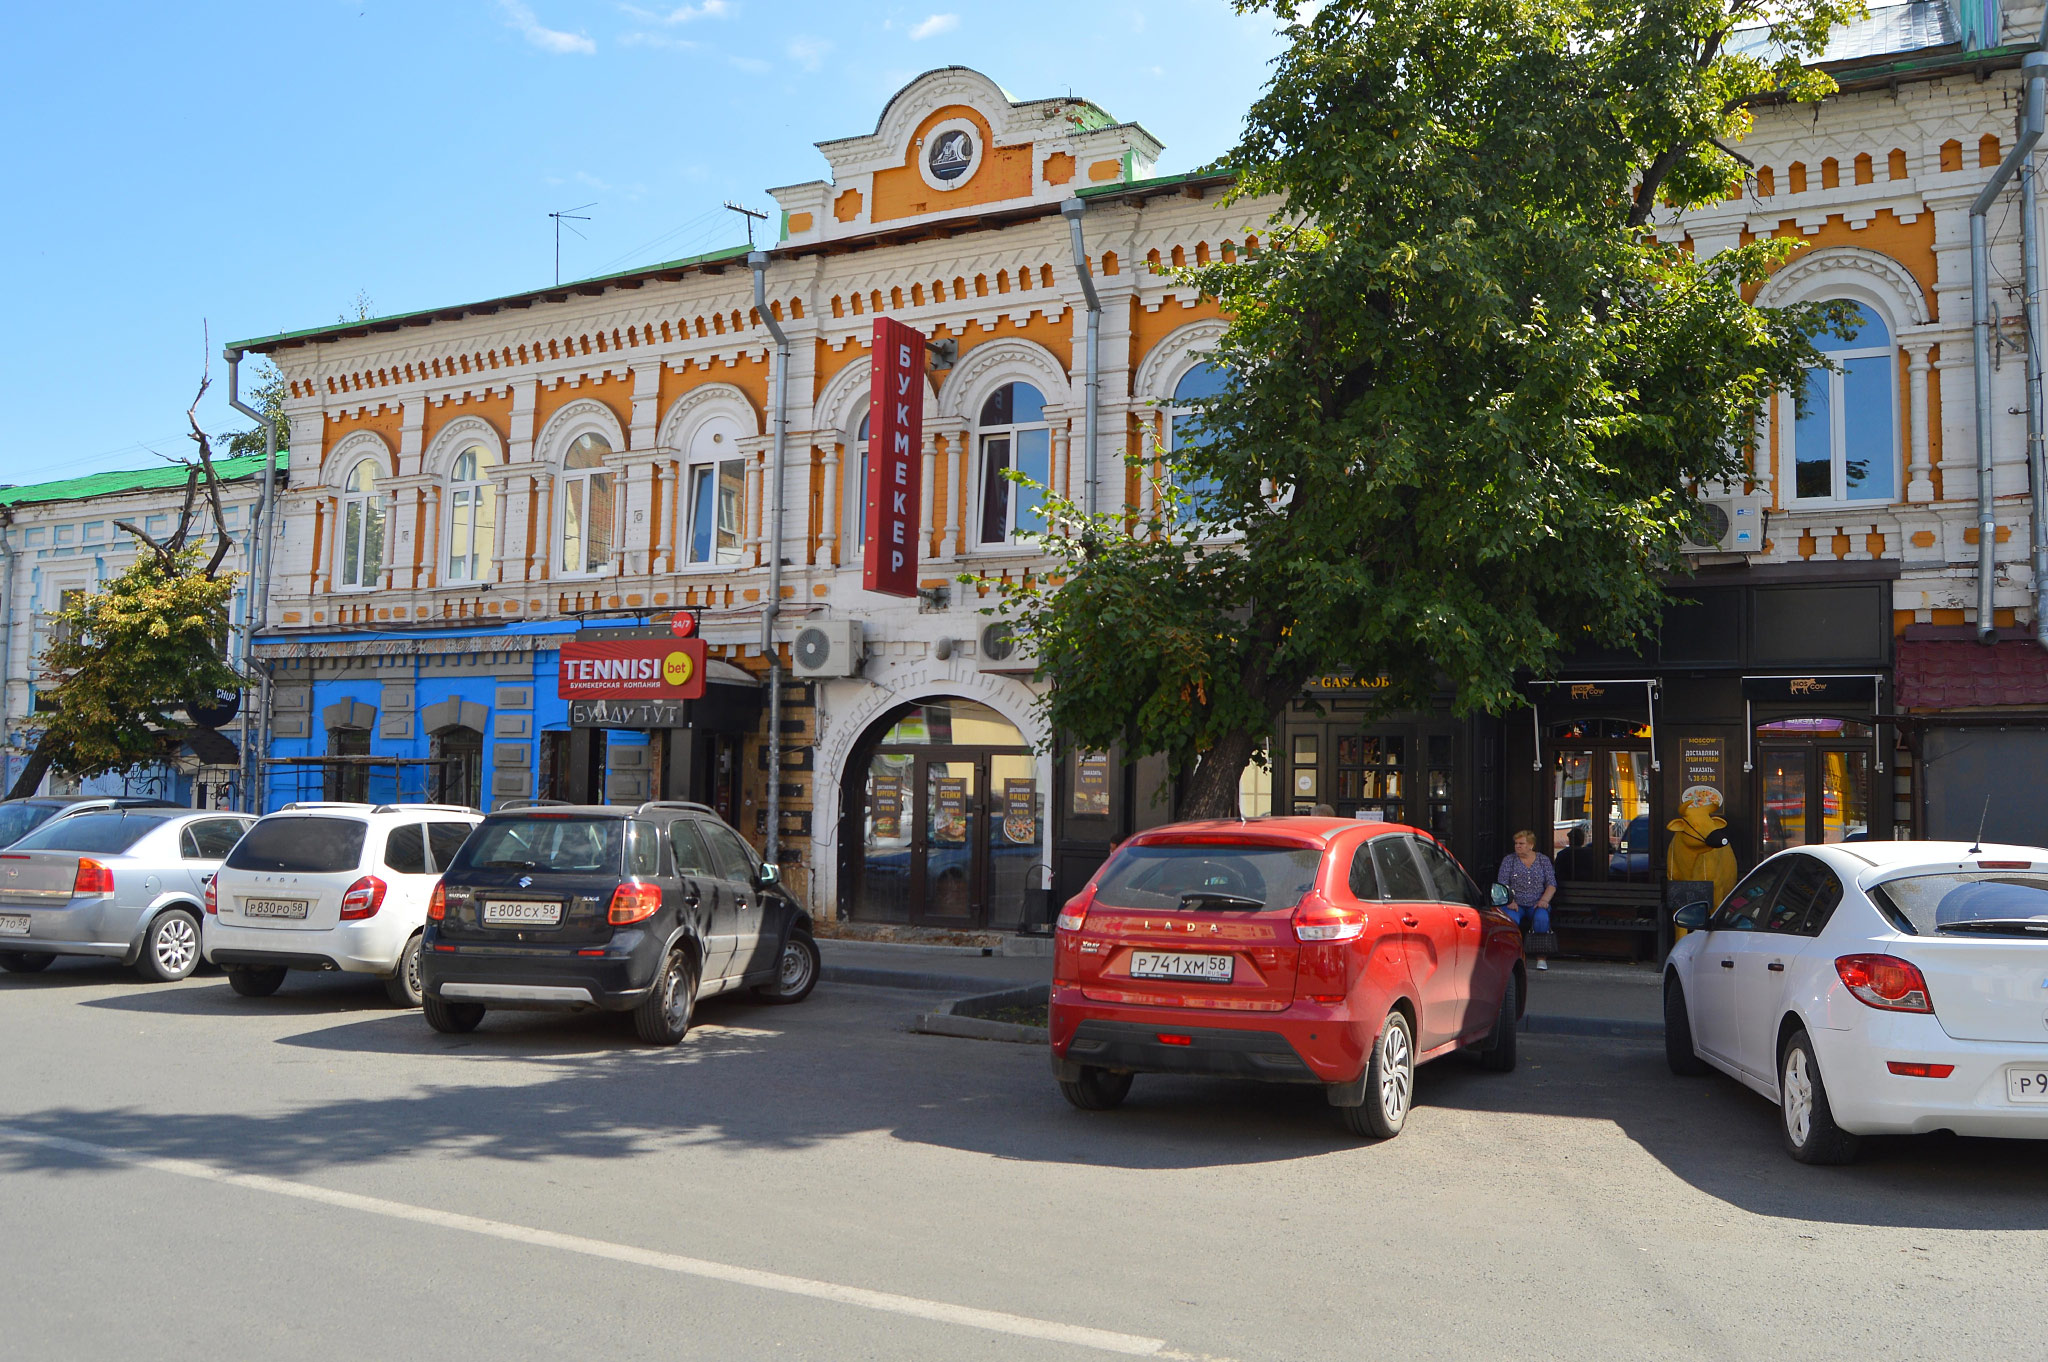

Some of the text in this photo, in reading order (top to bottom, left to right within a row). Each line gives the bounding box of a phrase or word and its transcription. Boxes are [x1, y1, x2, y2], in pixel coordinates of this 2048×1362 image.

[891, 343, 912, 573] БУКМЕКЕР
[673, 620, 690, 628] 24/7
[563, 658, 686, 680] TENNISI bet
[640, 705, 678, 723] ТУТ
[292, 903, 303, 912] 58
[543, 904, 555, 915] 58
[1144, 920, 1219, 933] LADA
[1209, 957, 1226, 971] 58
